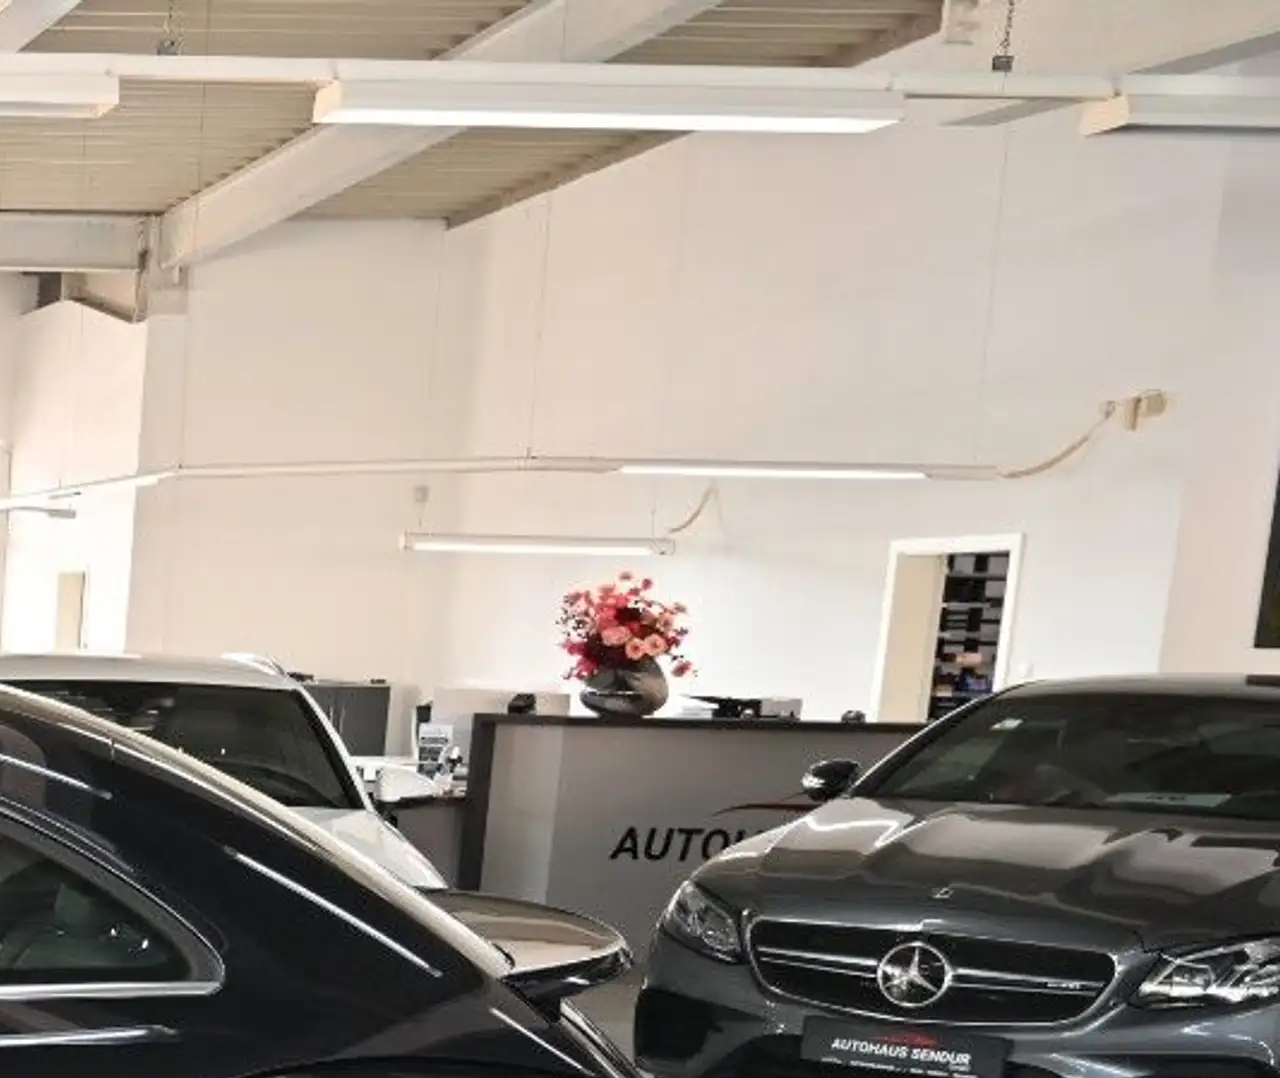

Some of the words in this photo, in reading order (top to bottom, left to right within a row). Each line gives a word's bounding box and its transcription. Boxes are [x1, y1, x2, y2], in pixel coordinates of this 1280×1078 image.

[610, 826, 764, 862] AUTO
[831, 1037, 909, 1060] AUTOHAUS
[910, 1048, 972, 1066] SENDUR
